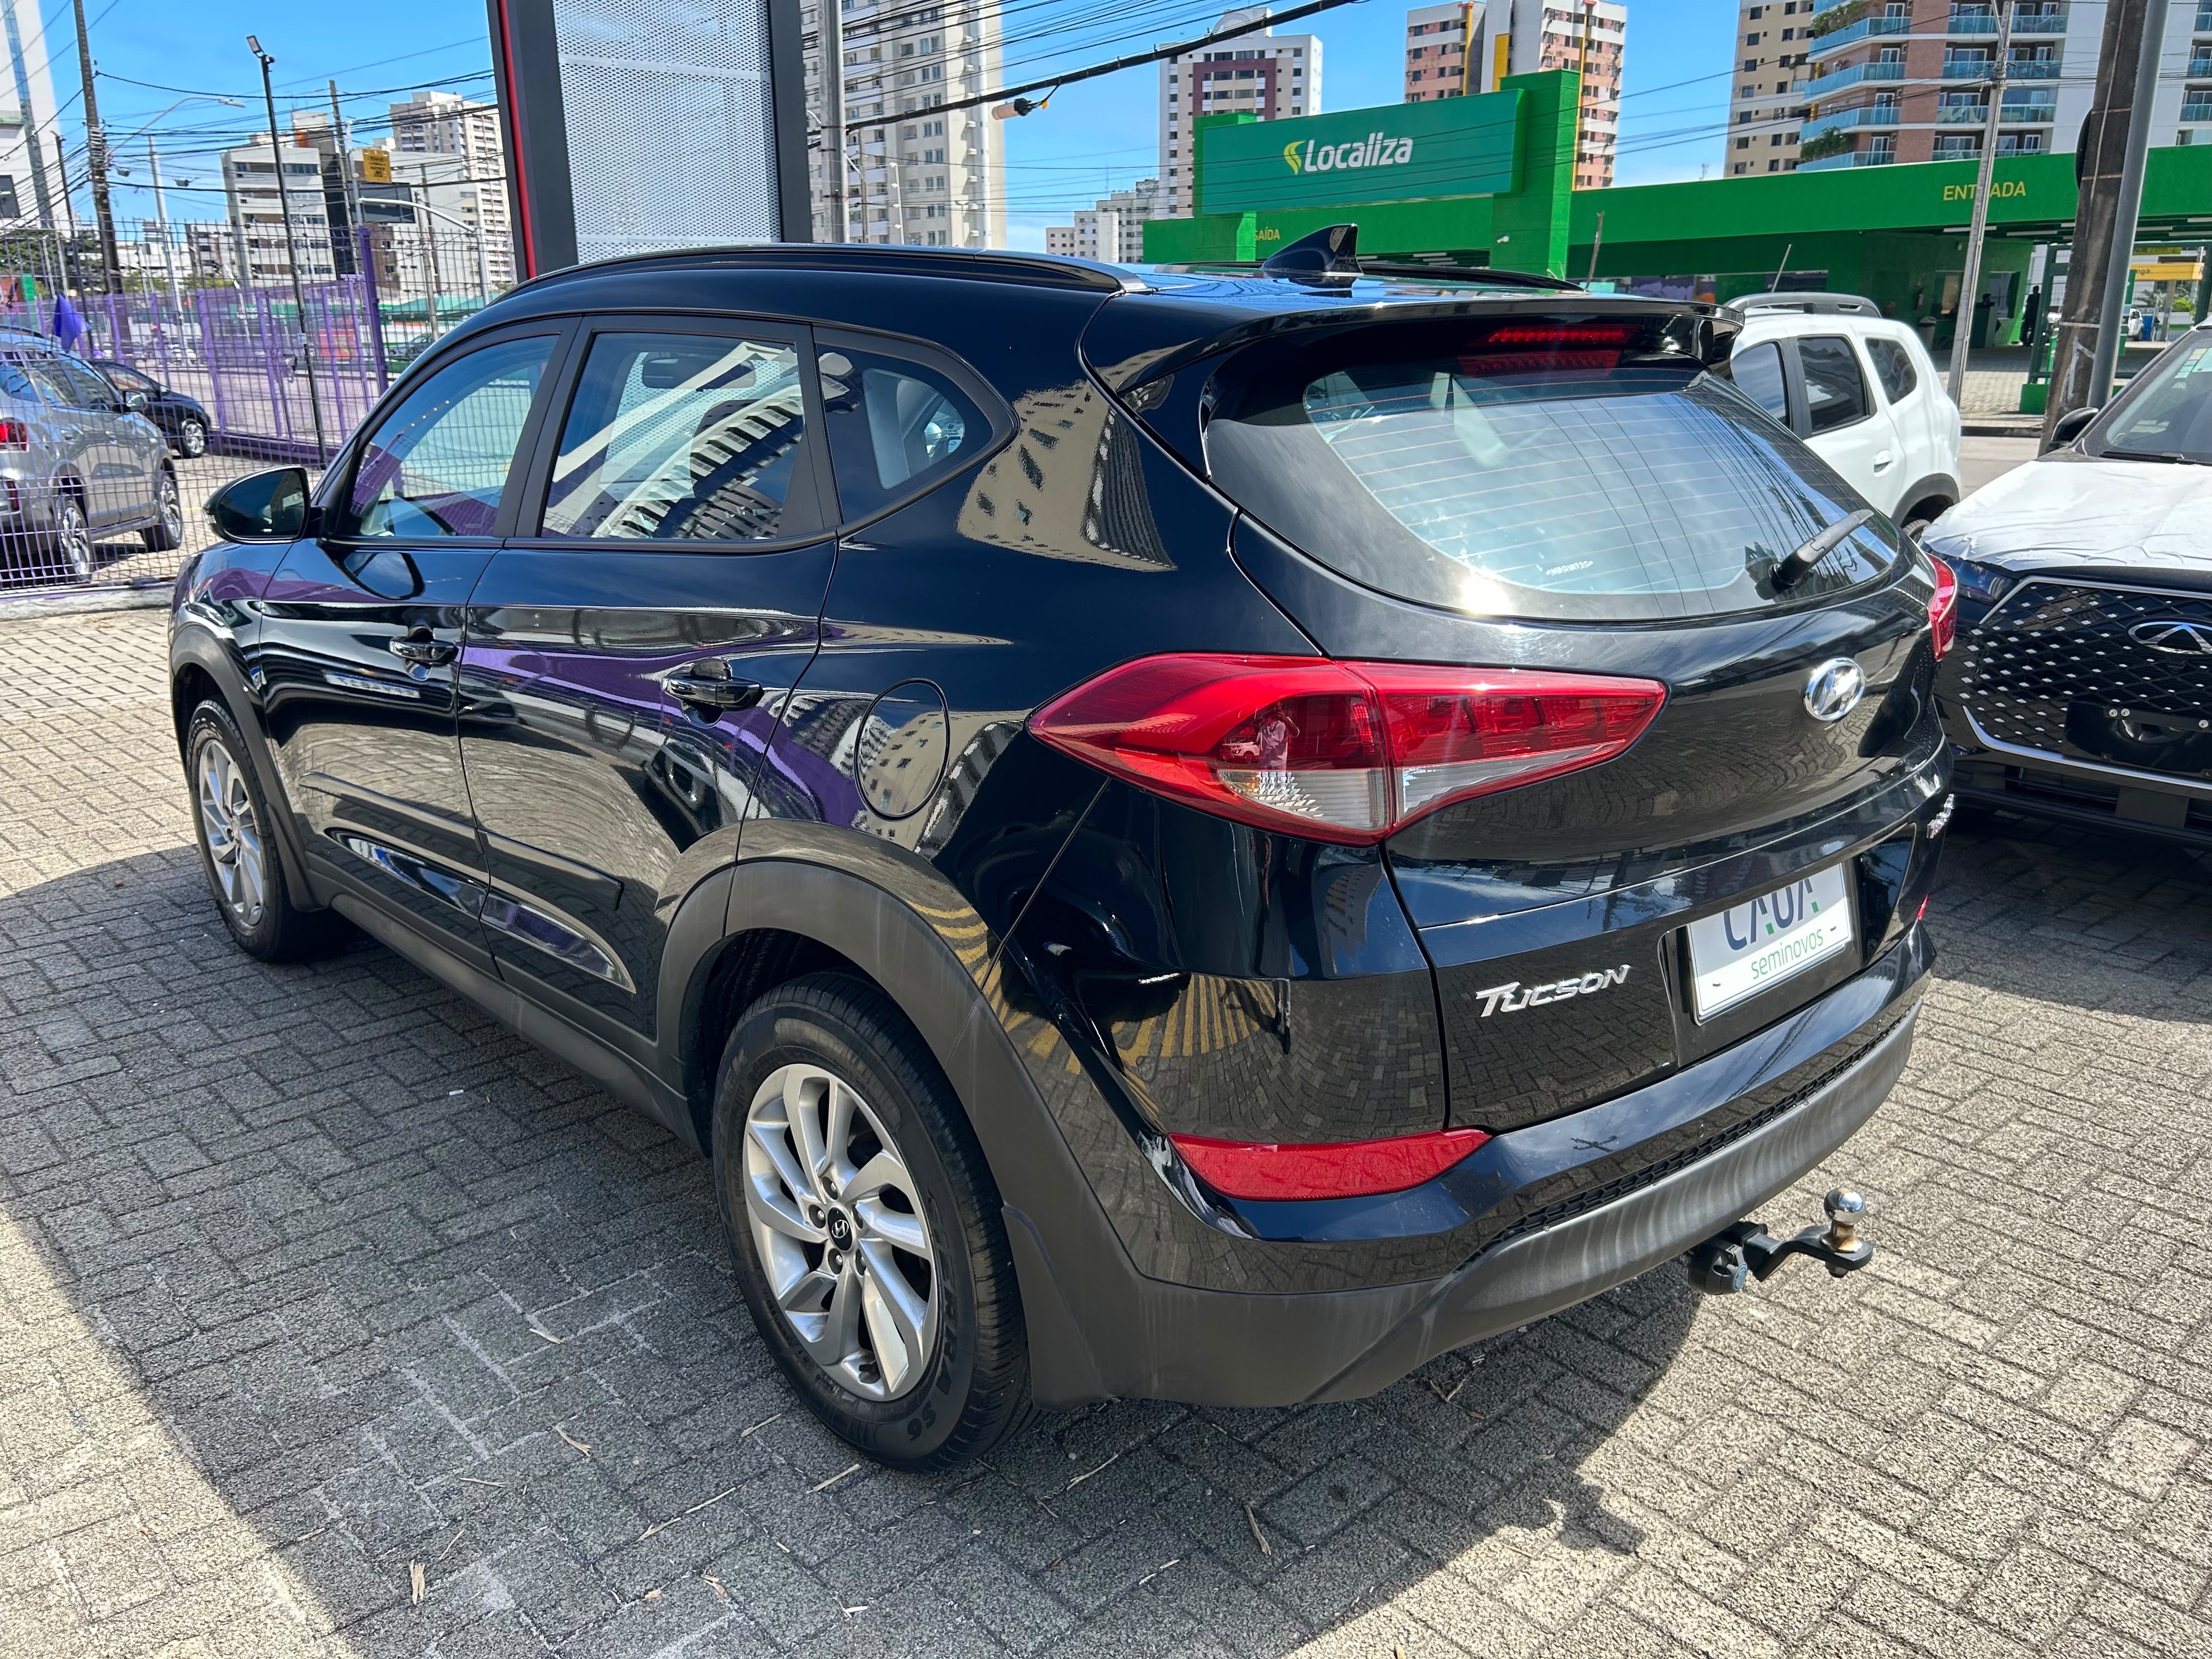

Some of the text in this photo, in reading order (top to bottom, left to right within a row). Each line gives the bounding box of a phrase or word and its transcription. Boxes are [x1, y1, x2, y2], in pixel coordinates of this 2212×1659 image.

[1304, 132, 1413, 172] Localiza
[1943, 180, 2027, 201] ENTADA
[1751, 929, 1824, 980] seminovos
[907, 1400, 936, 1441] S6
